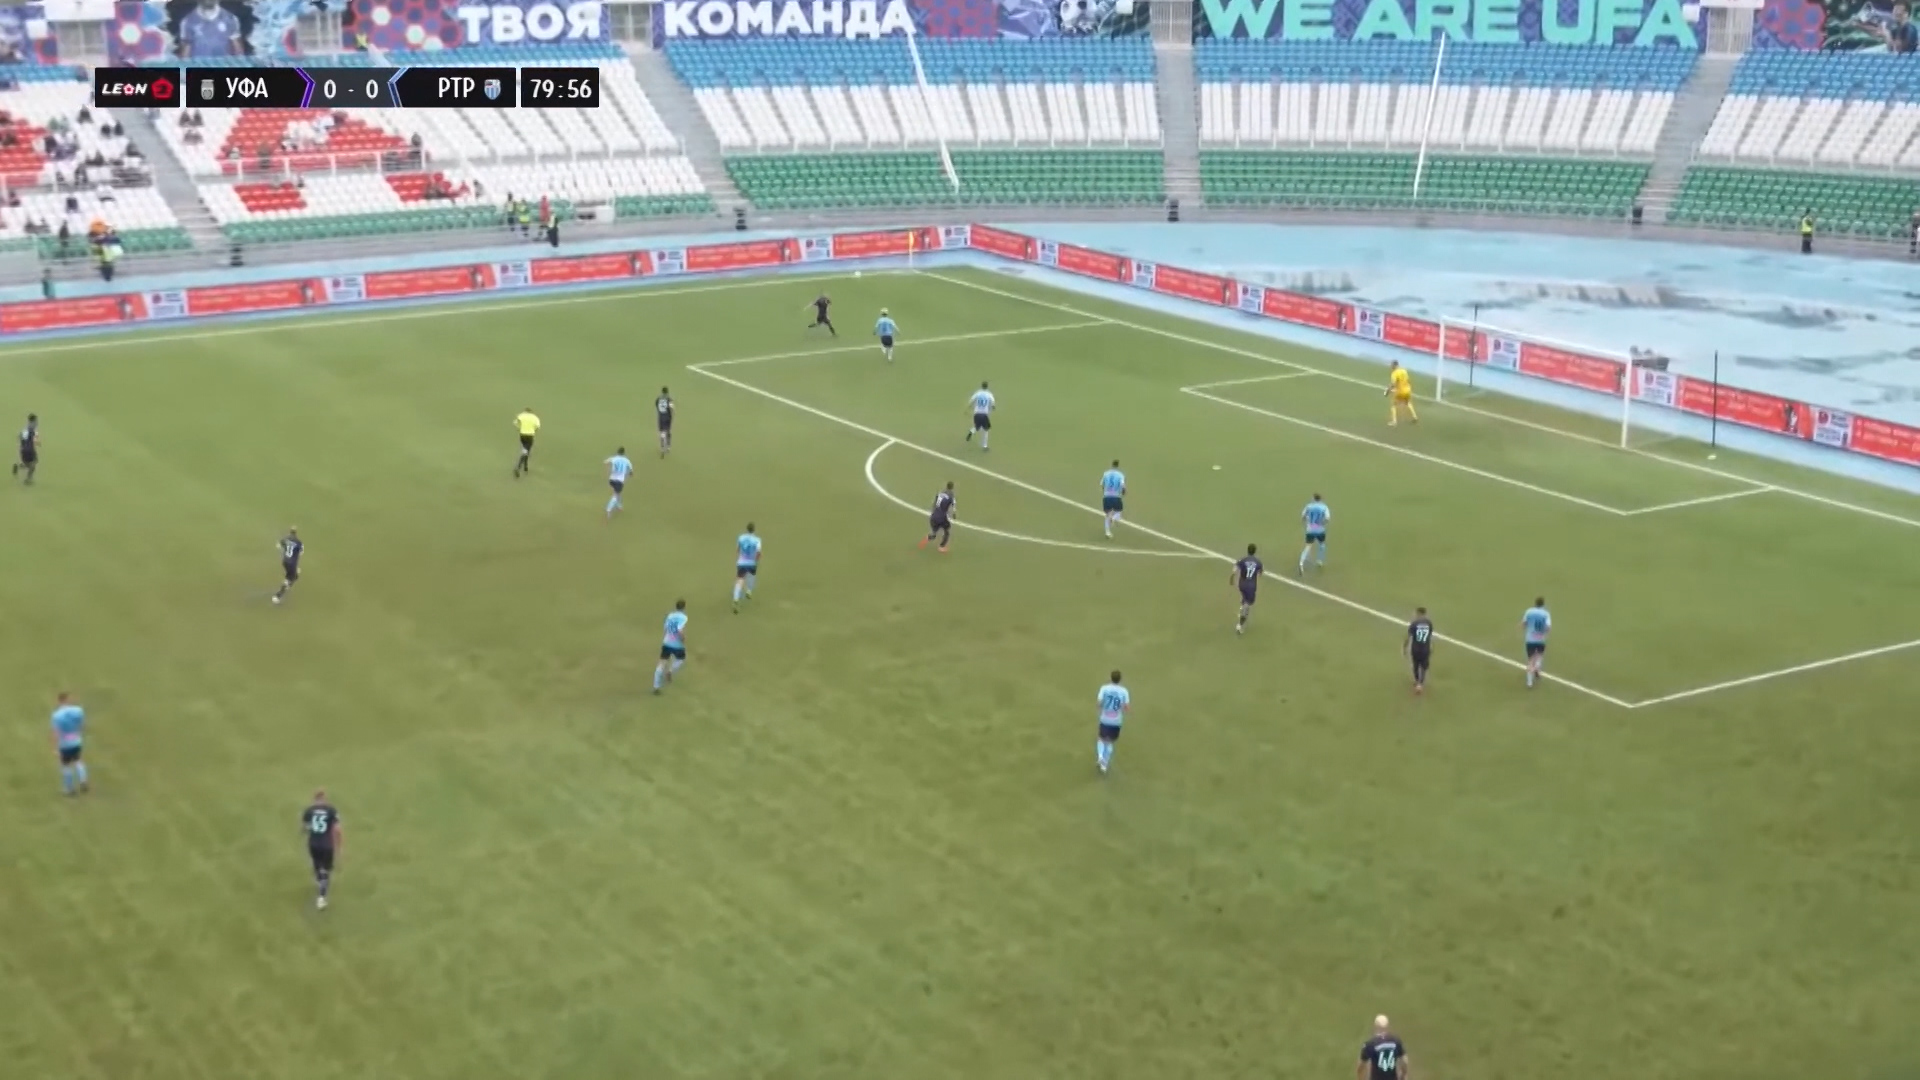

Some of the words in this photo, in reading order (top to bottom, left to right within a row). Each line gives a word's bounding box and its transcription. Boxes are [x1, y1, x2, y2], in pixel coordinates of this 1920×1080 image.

[458, 1, 600, 43] ТВОЯ
[664, 0, 917, 40] КОМАНДА
[1200, 0, 1334, 41] WE
[1352, 0, 1520, 44] ARE
[1541, 0, 1699, 49] UFA
